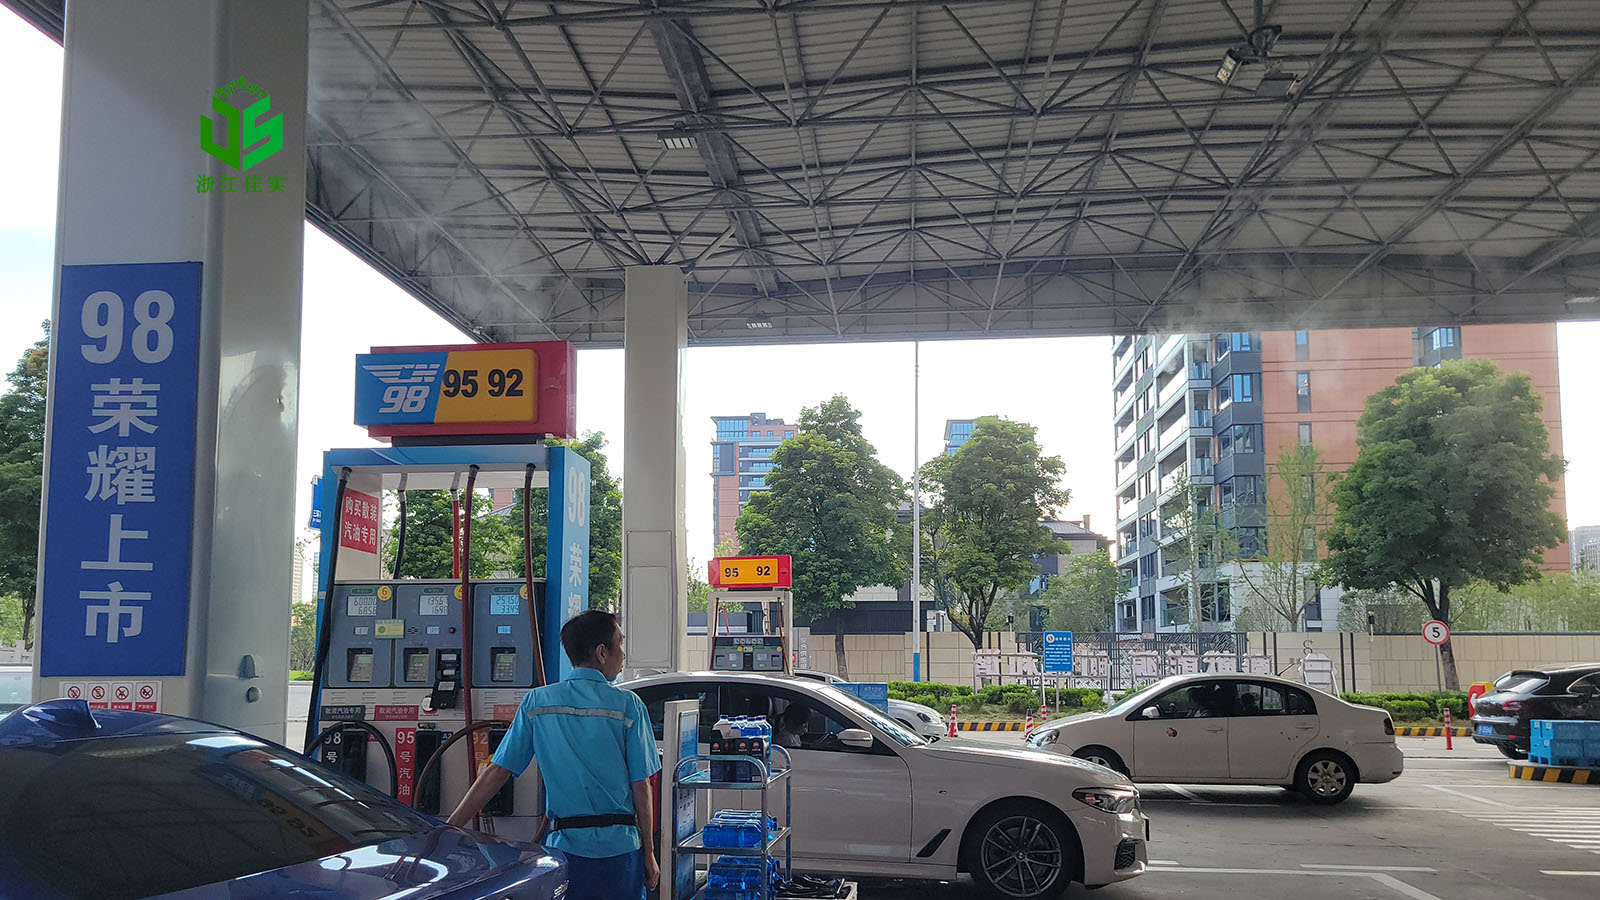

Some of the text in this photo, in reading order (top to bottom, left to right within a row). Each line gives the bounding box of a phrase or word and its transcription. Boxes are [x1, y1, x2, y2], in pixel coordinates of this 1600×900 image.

[442, 369, 523, 398] 95 92
[379, 386, 430, 413] 98
[345, 496, 377, 522] 购买散装
[344, 521, 377, 546] 汽油专用
[724, 566, 771, 577] 95 92
[1433, 627, 1441, 638] 5
